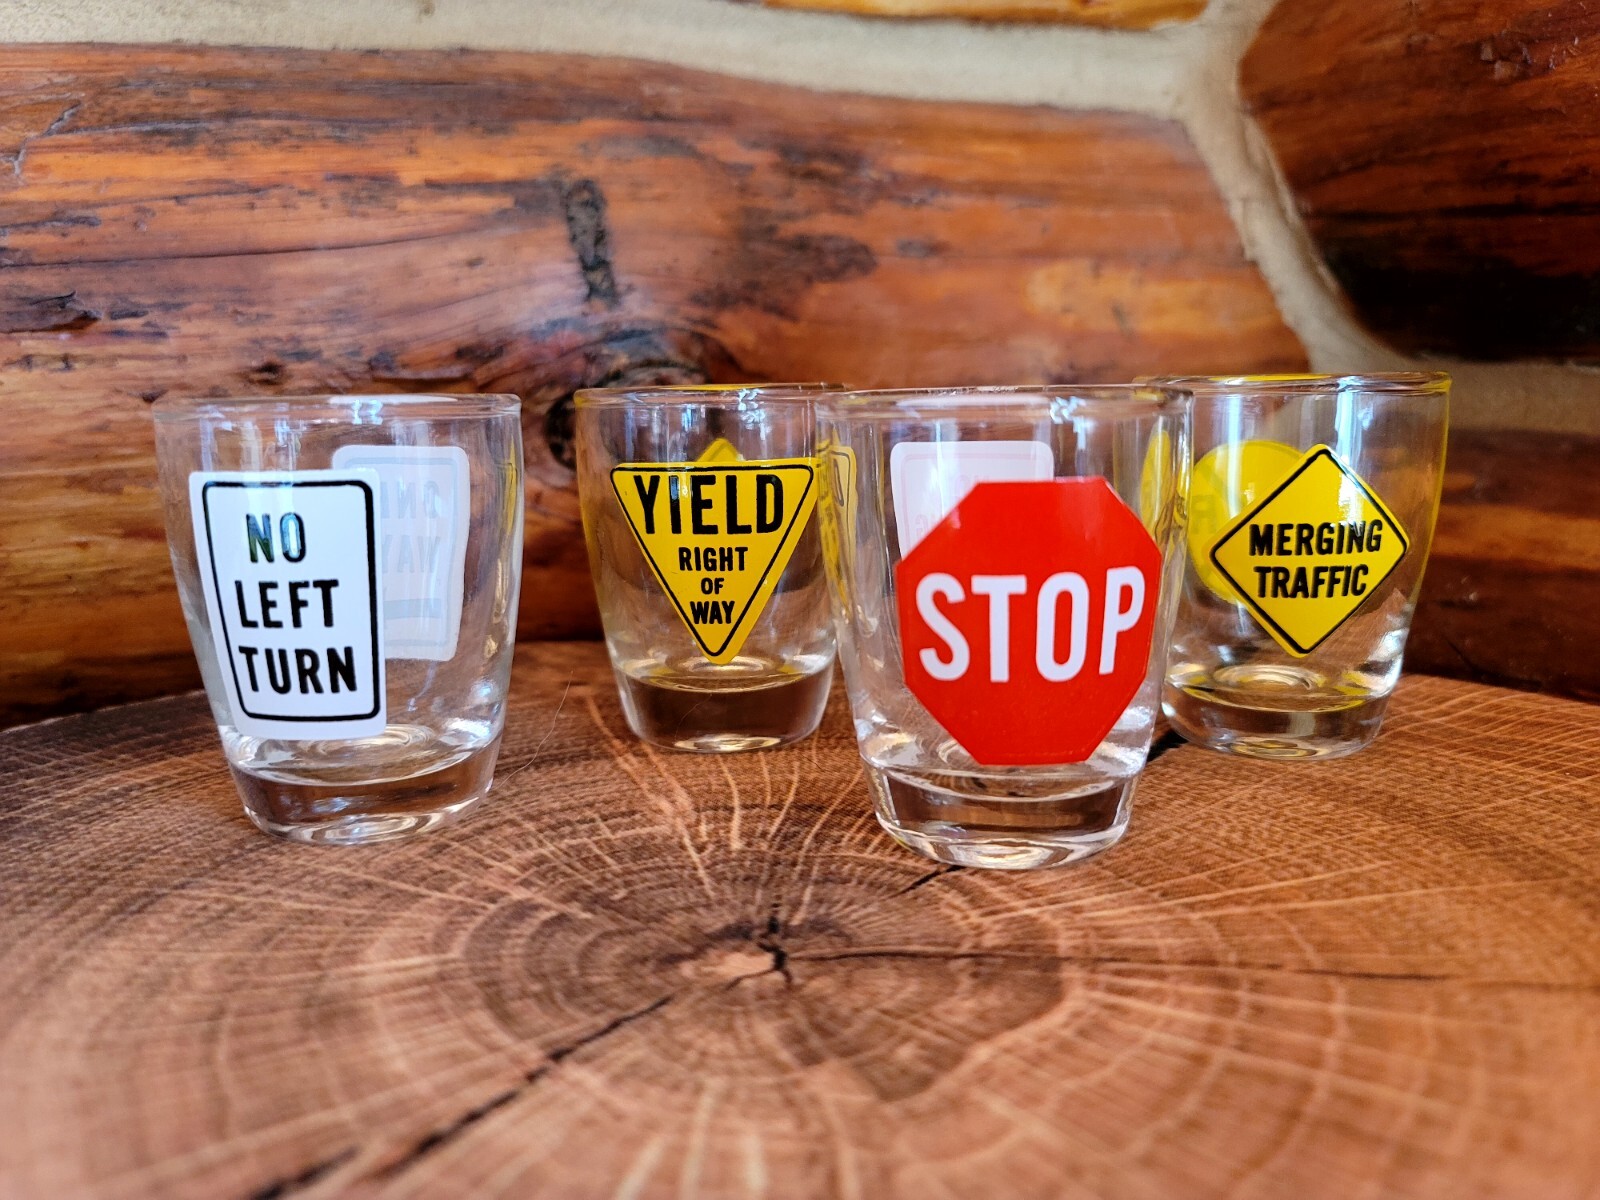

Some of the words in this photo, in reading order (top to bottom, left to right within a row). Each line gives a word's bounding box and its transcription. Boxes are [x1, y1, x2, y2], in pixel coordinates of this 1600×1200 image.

[633, 474, 784, 534] YIELD
[245, 512, 306, 563] NO
[678, 547, 748, 571] RIGHT
[1249, 519, 1383, 556] MERGING
[701, 577, 724, 594] OF
[1254, 564, 1369, 599] TRAFFIC
[234, 579, 339, 628] LEFT
[690, 600, 735, 624] WAY
[916, 565, 1145, 683] STOP
[238, 646, 358, 695] TURN
